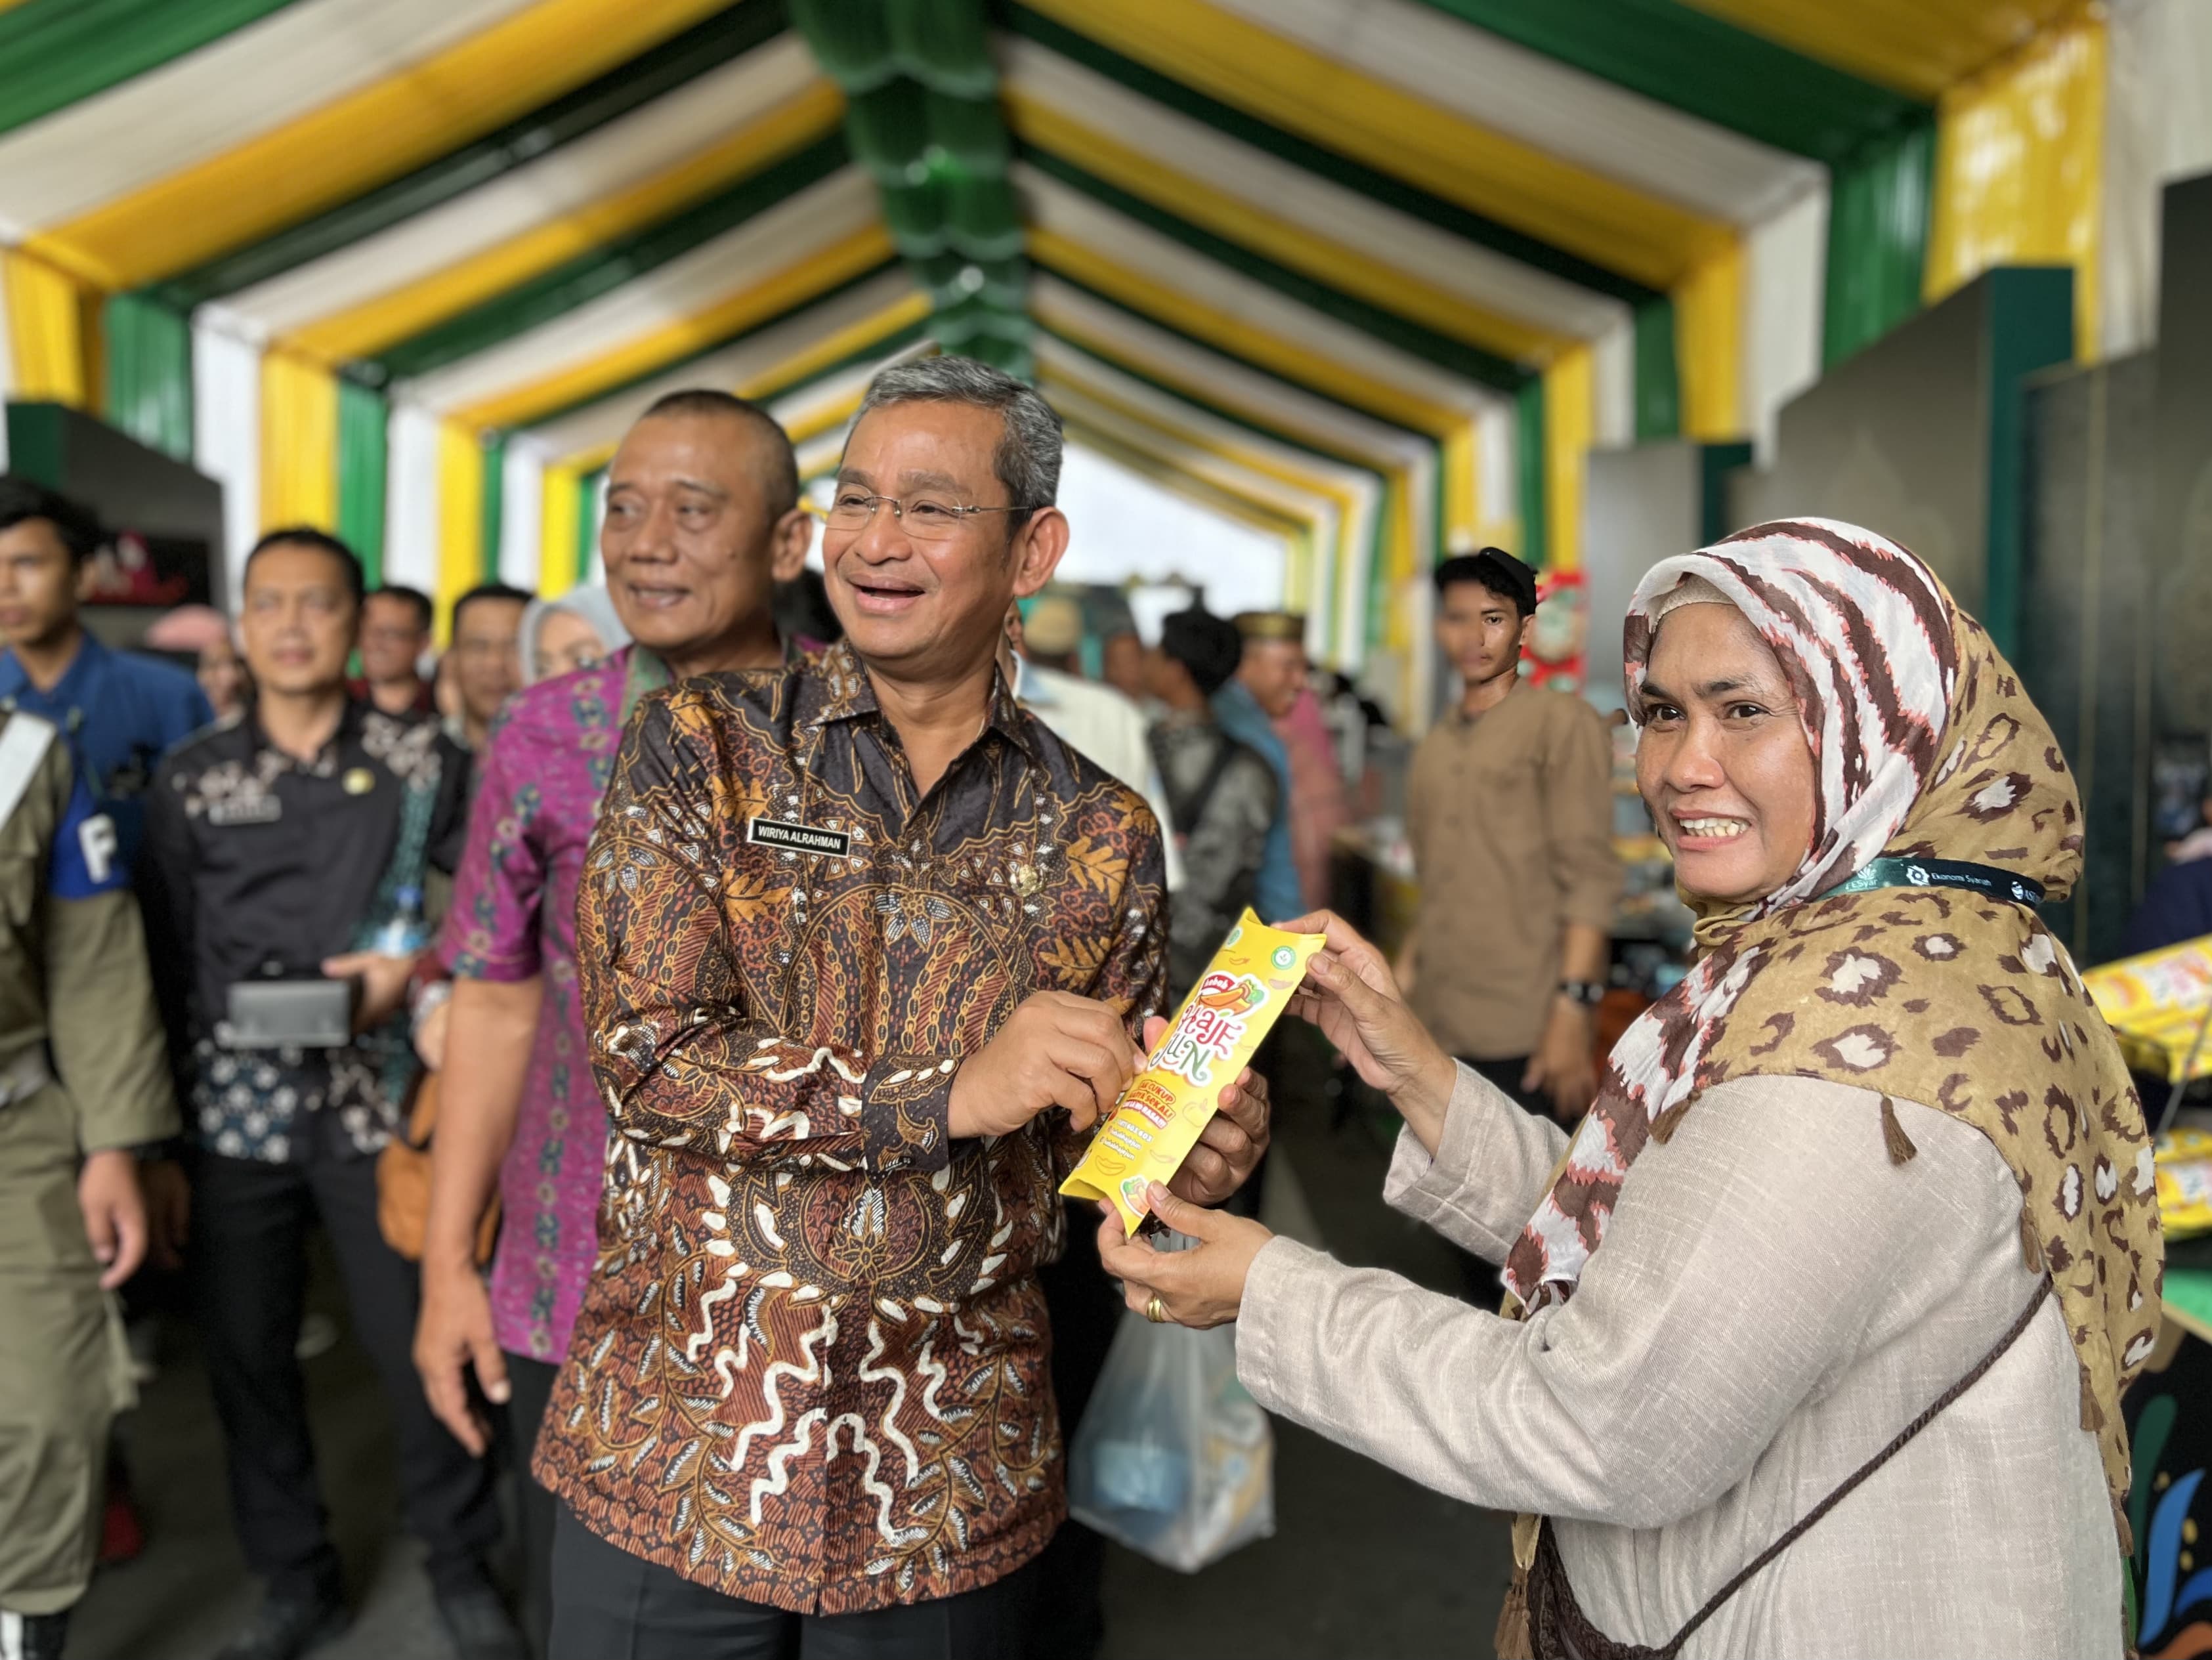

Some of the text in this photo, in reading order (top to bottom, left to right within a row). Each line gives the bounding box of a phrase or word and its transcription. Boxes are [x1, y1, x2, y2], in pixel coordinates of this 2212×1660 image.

[758, 825, 841, 849] WIRIYA ALRAHMAN
[1149, 1083, 1174, 1103] CUKUP
